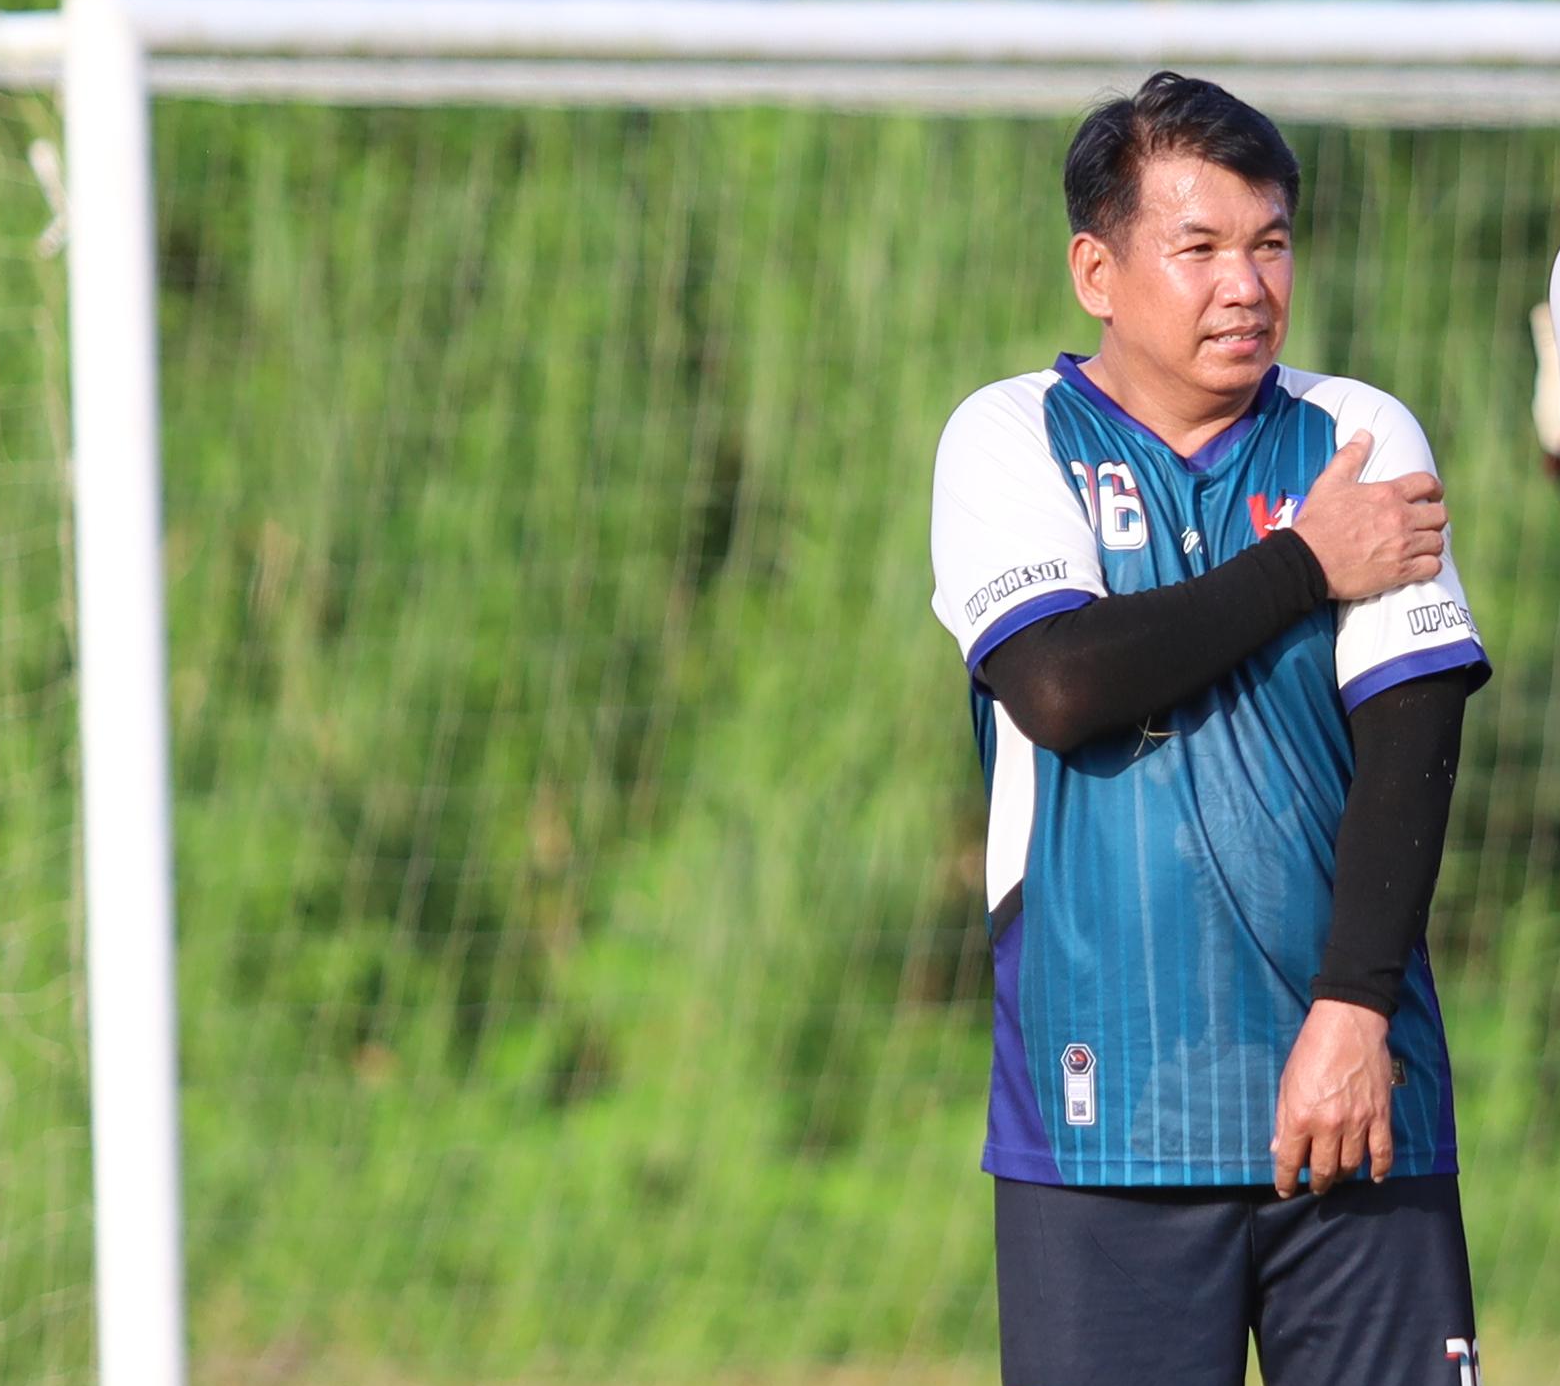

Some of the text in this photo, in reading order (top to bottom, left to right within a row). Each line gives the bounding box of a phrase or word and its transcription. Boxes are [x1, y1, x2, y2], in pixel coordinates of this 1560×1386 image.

[965, 558, 1067, 625] VIP MAESOT
[1407, 604, 1441, 636] VIP
